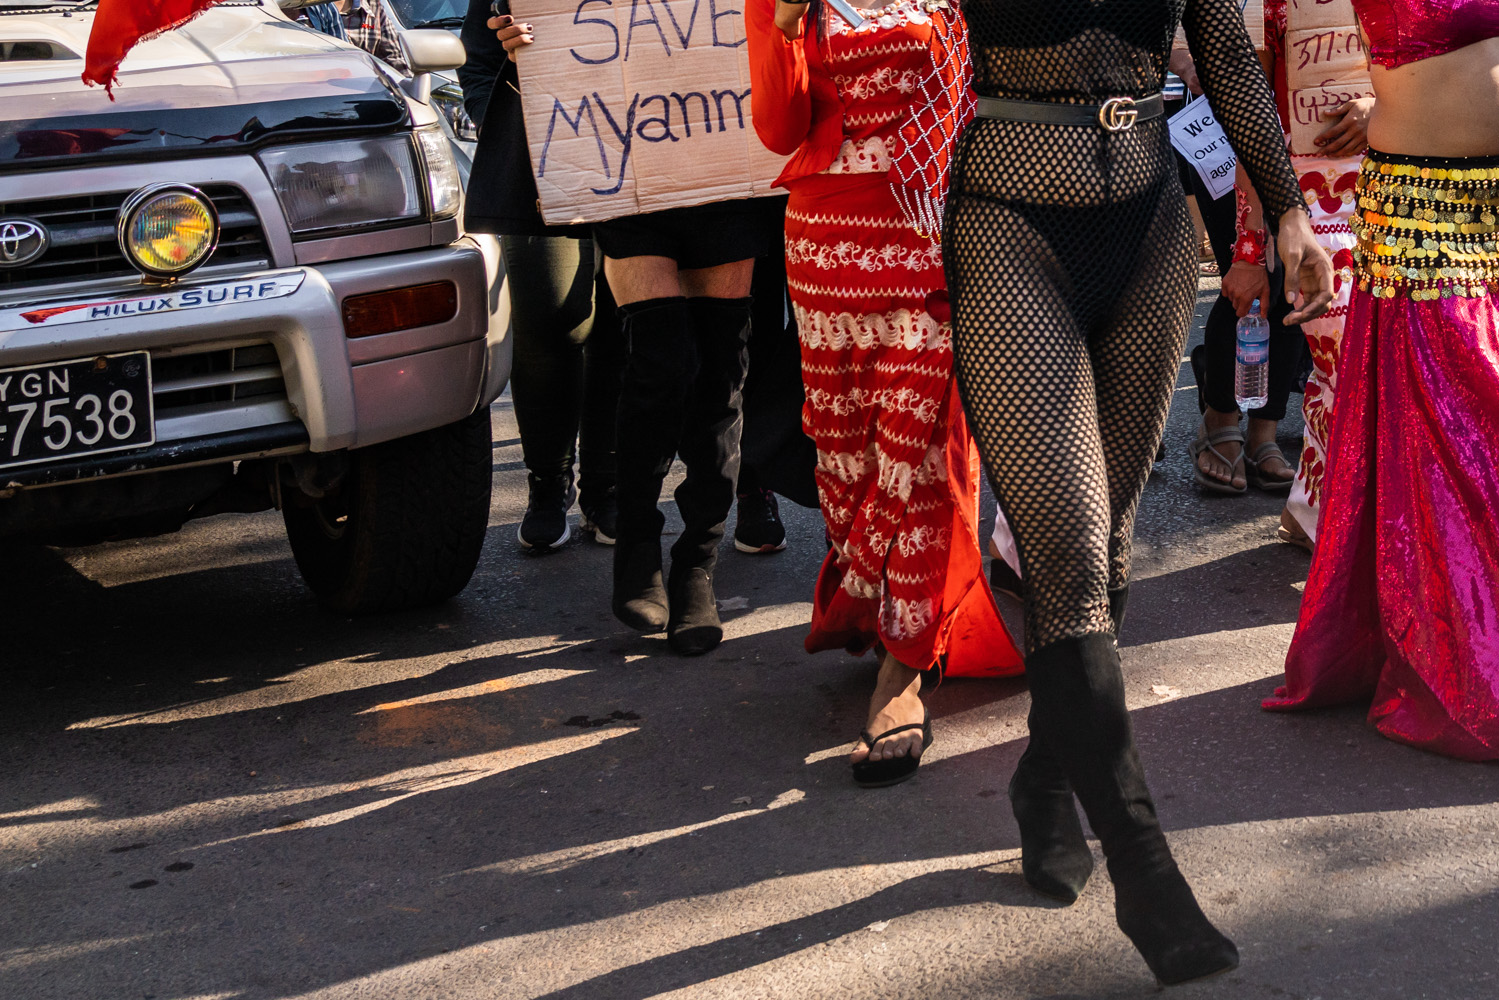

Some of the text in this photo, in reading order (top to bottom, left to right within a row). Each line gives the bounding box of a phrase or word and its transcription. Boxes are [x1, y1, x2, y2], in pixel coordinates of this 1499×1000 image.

[537, 88, 752, 196] Myanm
[1183, 116, 1215, 138] We
[92, 281, 277, 319] HILUX SURF
[0, 368, 70, 402] YGN
